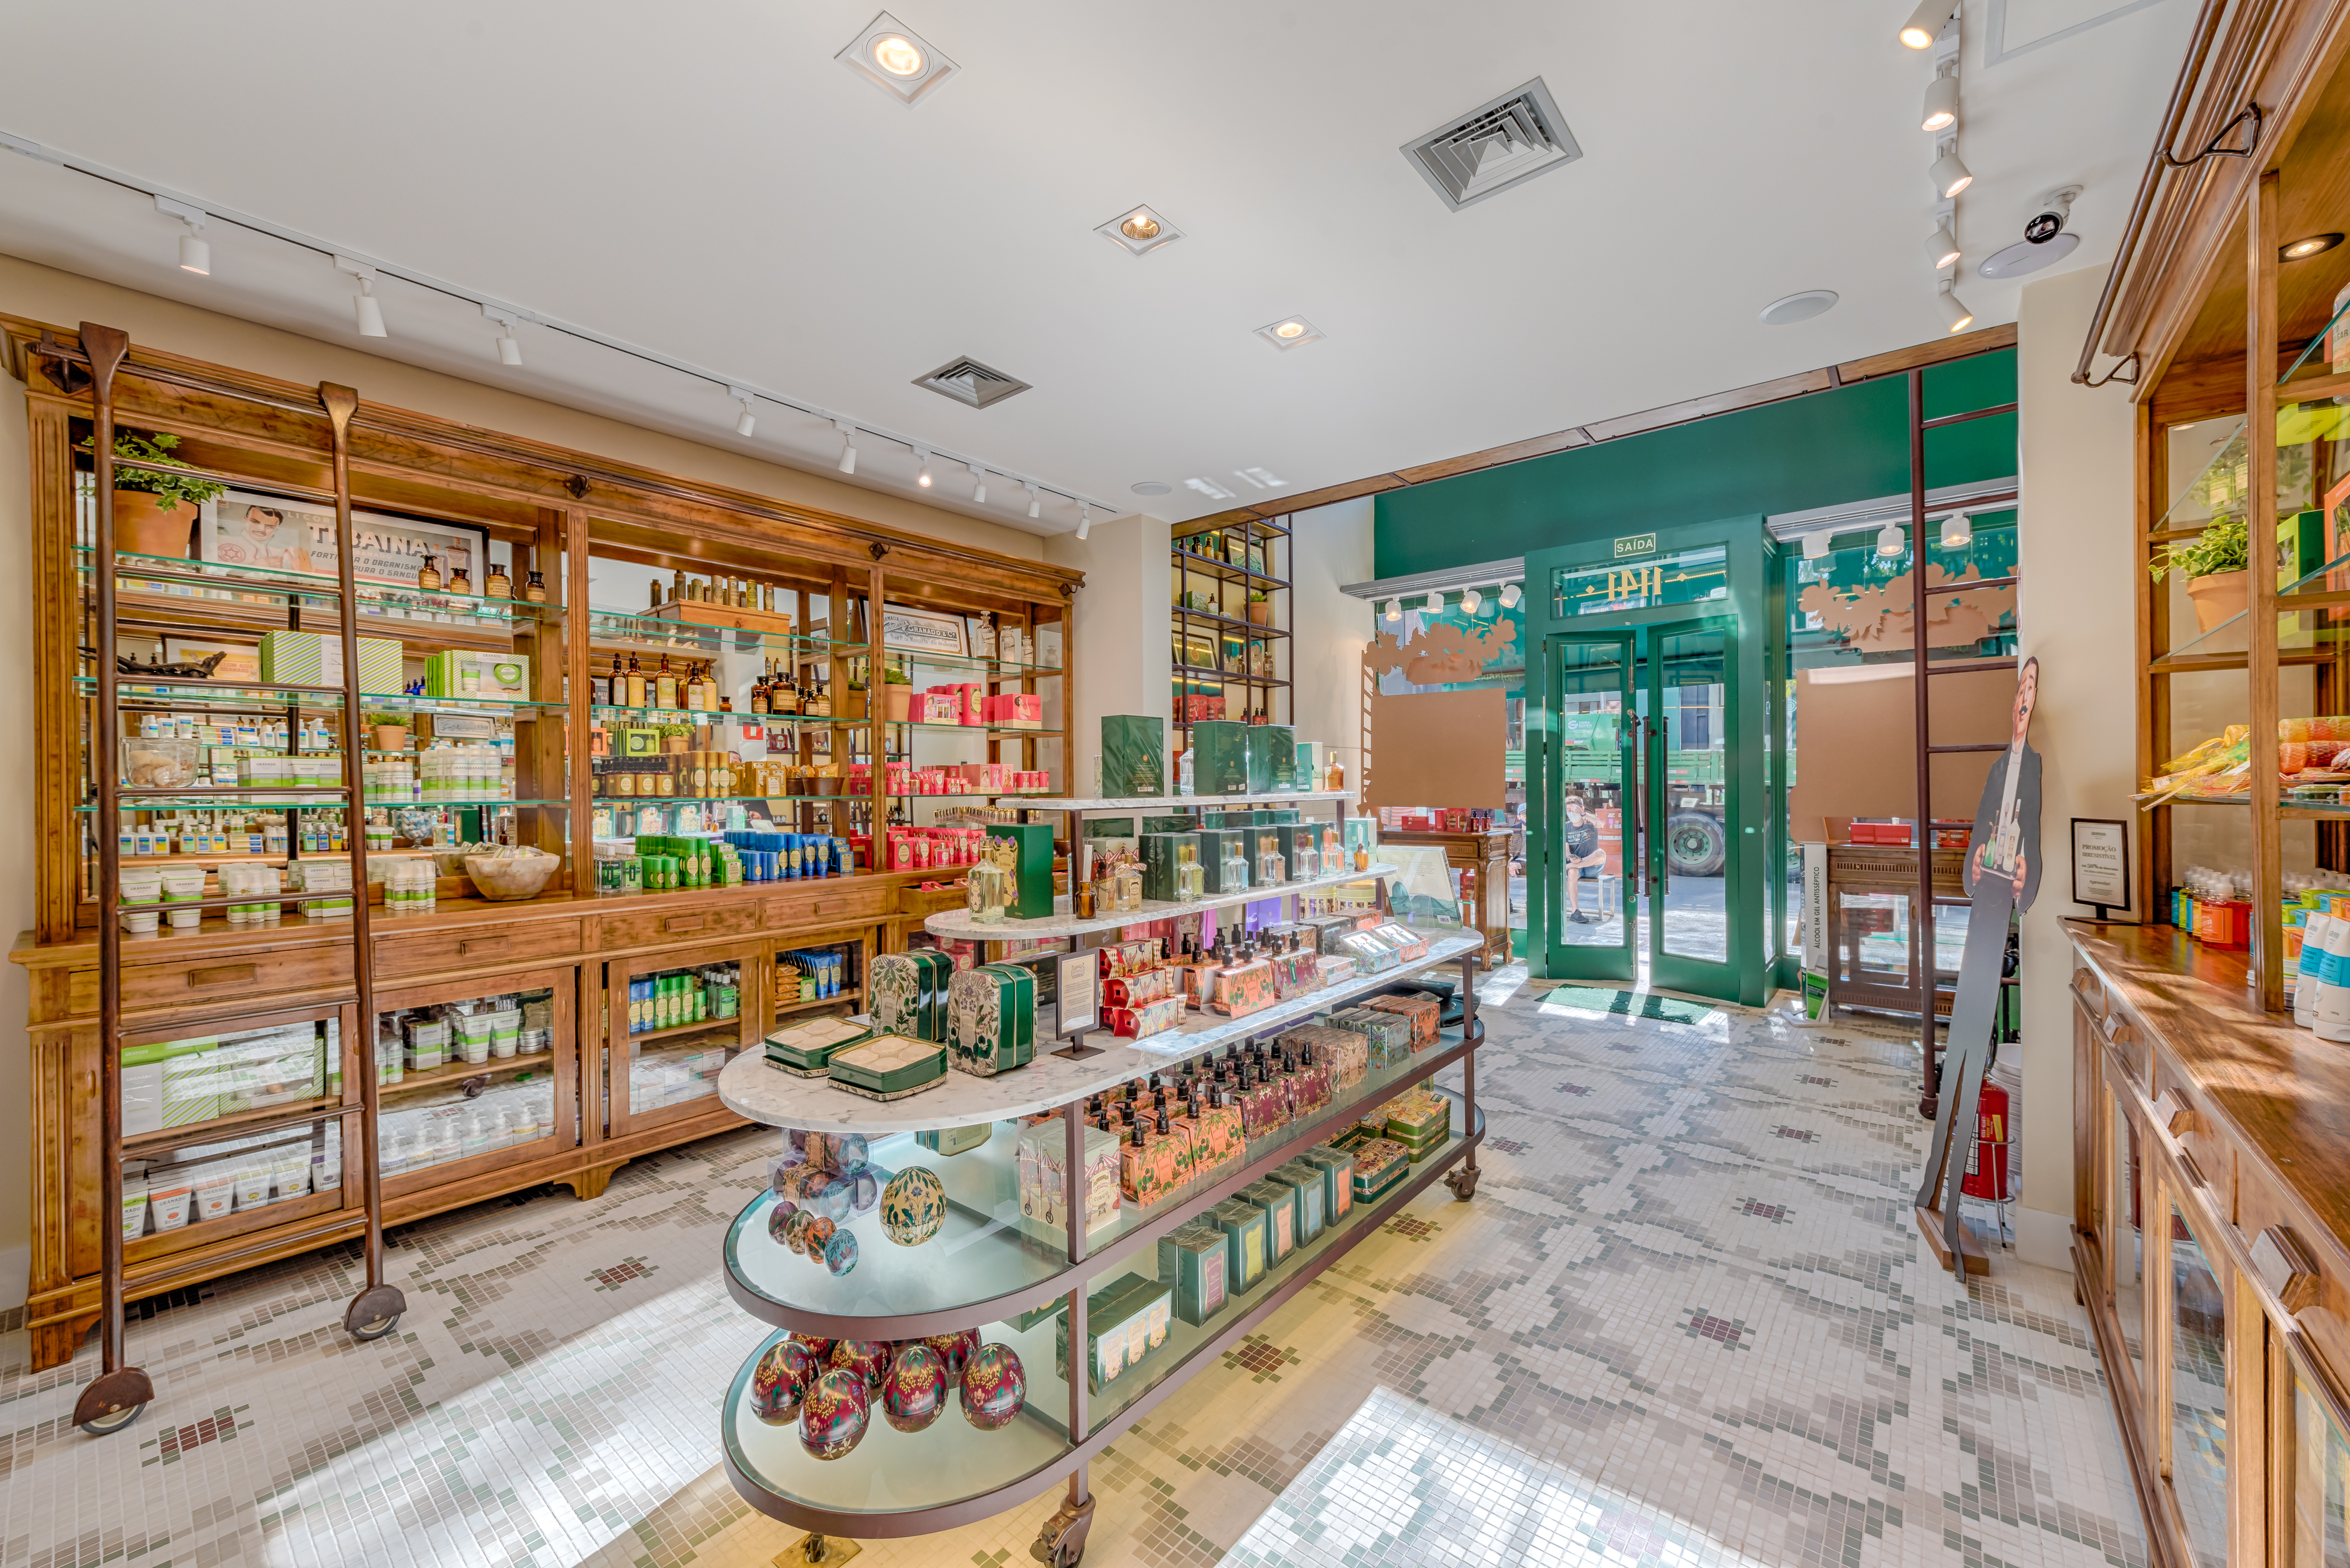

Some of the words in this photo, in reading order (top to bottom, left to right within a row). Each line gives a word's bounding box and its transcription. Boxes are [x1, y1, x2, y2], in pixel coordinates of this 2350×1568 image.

[287, 511, 330, 523] LICOR
[1617, 539, 1653, 553] SAÍDA
[311, 551, 360, 564] FORTIA
[354, 565, 376, 574] PURA
[387, 570, 419, 579] SANGU
[885, 621, 906, 631] DROGARIA
[908, 625, 941, 636] GRANADO
[2082, 844, 2116, 853] PROMOÇÃO
[1443, 854, 1453, 888] GRANADO
[1808, 975, 1827, 984] GRANADO
[962, 1022, 973, 1030] Verbena
[1396, 1090, 1413, 1101] RANADO
[204, 1187, 229, 1195] GRANADO
[1093, 1191, 1109, 1202] CIRCO
[159, 1197, 186, 1206] GRANADO
